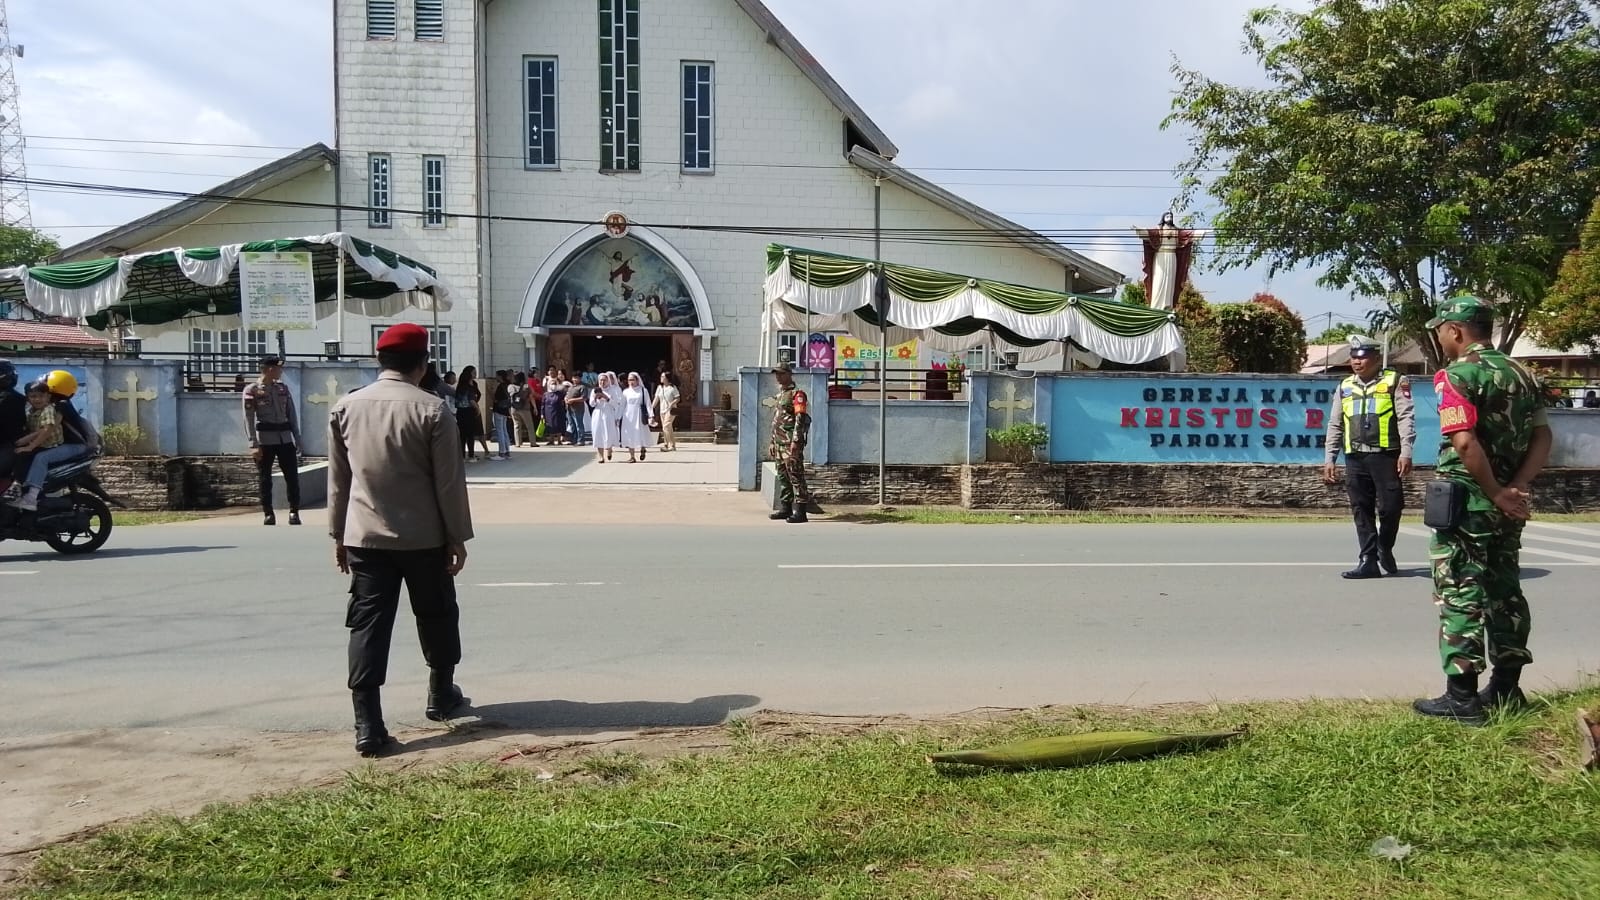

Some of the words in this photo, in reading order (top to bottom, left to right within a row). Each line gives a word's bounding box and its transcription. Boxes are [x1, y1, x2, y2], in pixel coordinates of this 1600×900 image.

[859, 348, 894, 359] Easr
[1142, 387, 1248, 403] GEREJA
[1261, 388, 1336, 404] KATO
[1120, 407, 1278, 428] KRISTUS
[1304, 408, 1324, 429] R
[1150, 433, 1249, 448] PAROKI
[1262, 433, 1327, 448] SAMB
